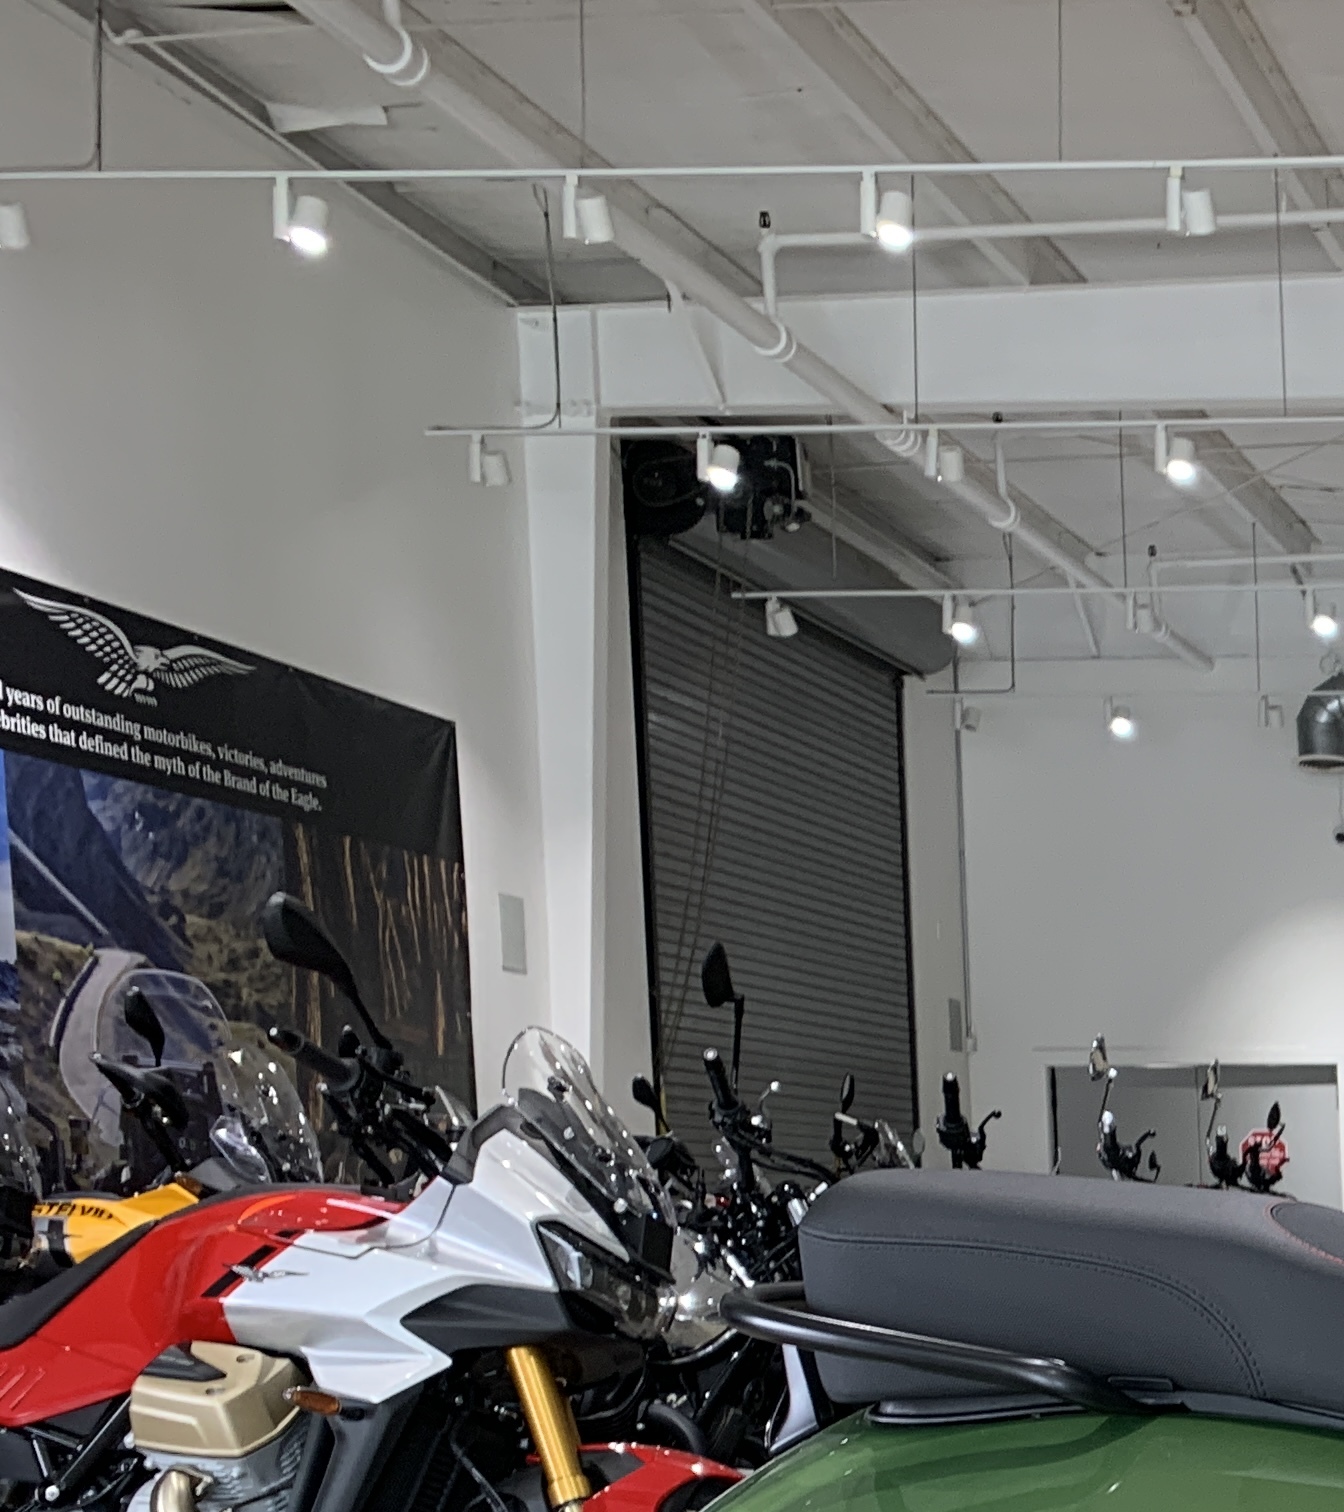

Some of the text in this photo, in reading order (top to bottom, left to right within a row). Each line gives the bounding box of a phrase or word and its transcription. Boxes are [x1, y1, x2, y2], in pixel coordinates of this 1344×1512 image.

[0, 709, 46, 739] brities
[49, 722, 77, 748] that
[79, 731, 128, 761] defined
[131, 744, 151, 767] the
[154, 756, 186, 776] myth
[187, 760, 201, 779] of
[202, 763, 222, 785] the
[223, 768, 257, 794] Brand
[259, 779, 271, 797] of
[271, 782, 290, 803] the
[6, 686, 44, 711] years
[46, 695, 61, 715] of
[62, 702, 142, 741] outstanding
[143, 725, 216, 760] motorbikes,
[217, 743, 268, 774] victories,
[269, 758, 327, 789] adventures
